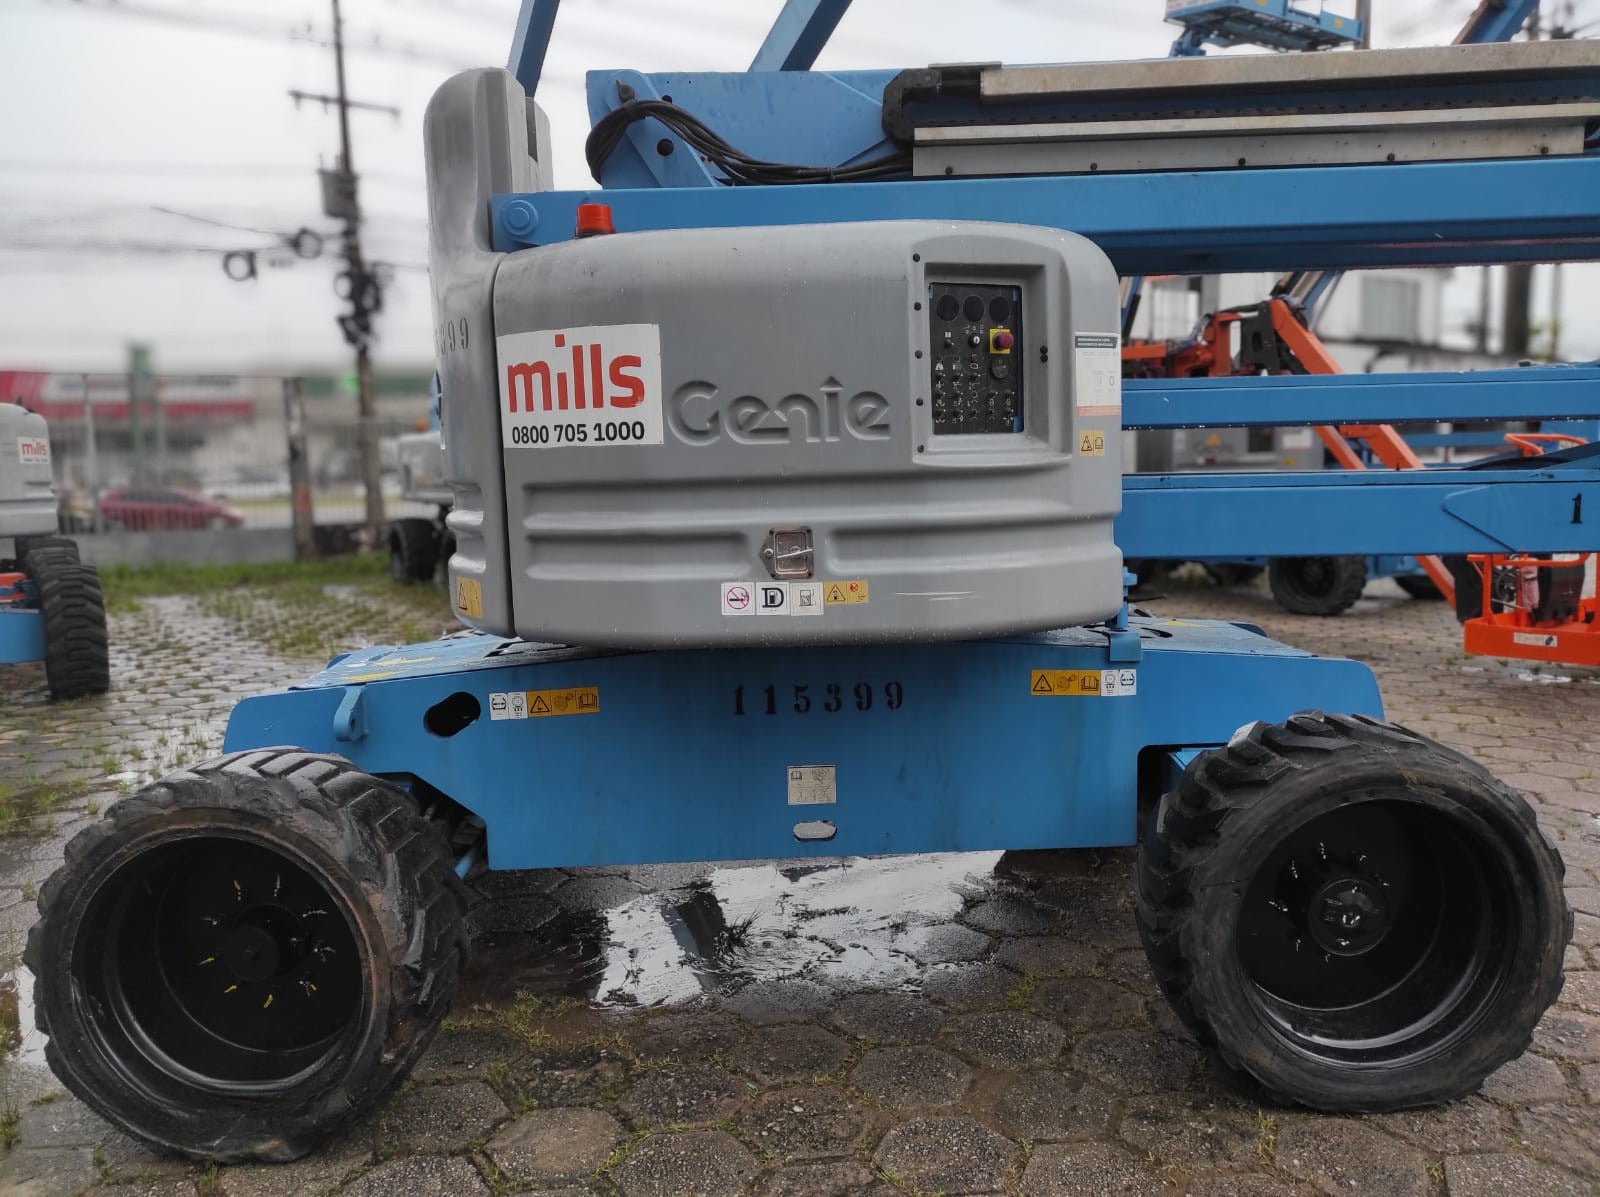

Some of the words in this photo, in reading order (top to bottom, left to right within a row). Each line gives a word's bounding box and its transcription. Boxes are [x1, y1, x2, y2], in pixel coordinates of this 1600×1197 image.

[507, 333, 646, 413] mills
[667, 375, 891, 446] Genie
[21, 439, 47, 456] mills
[512, 426, 549, 444] 0800
[553, 424, 588, 442] 705
[593, 421, 645, 441] 1000
[733, 680, 904, 715] 115399
